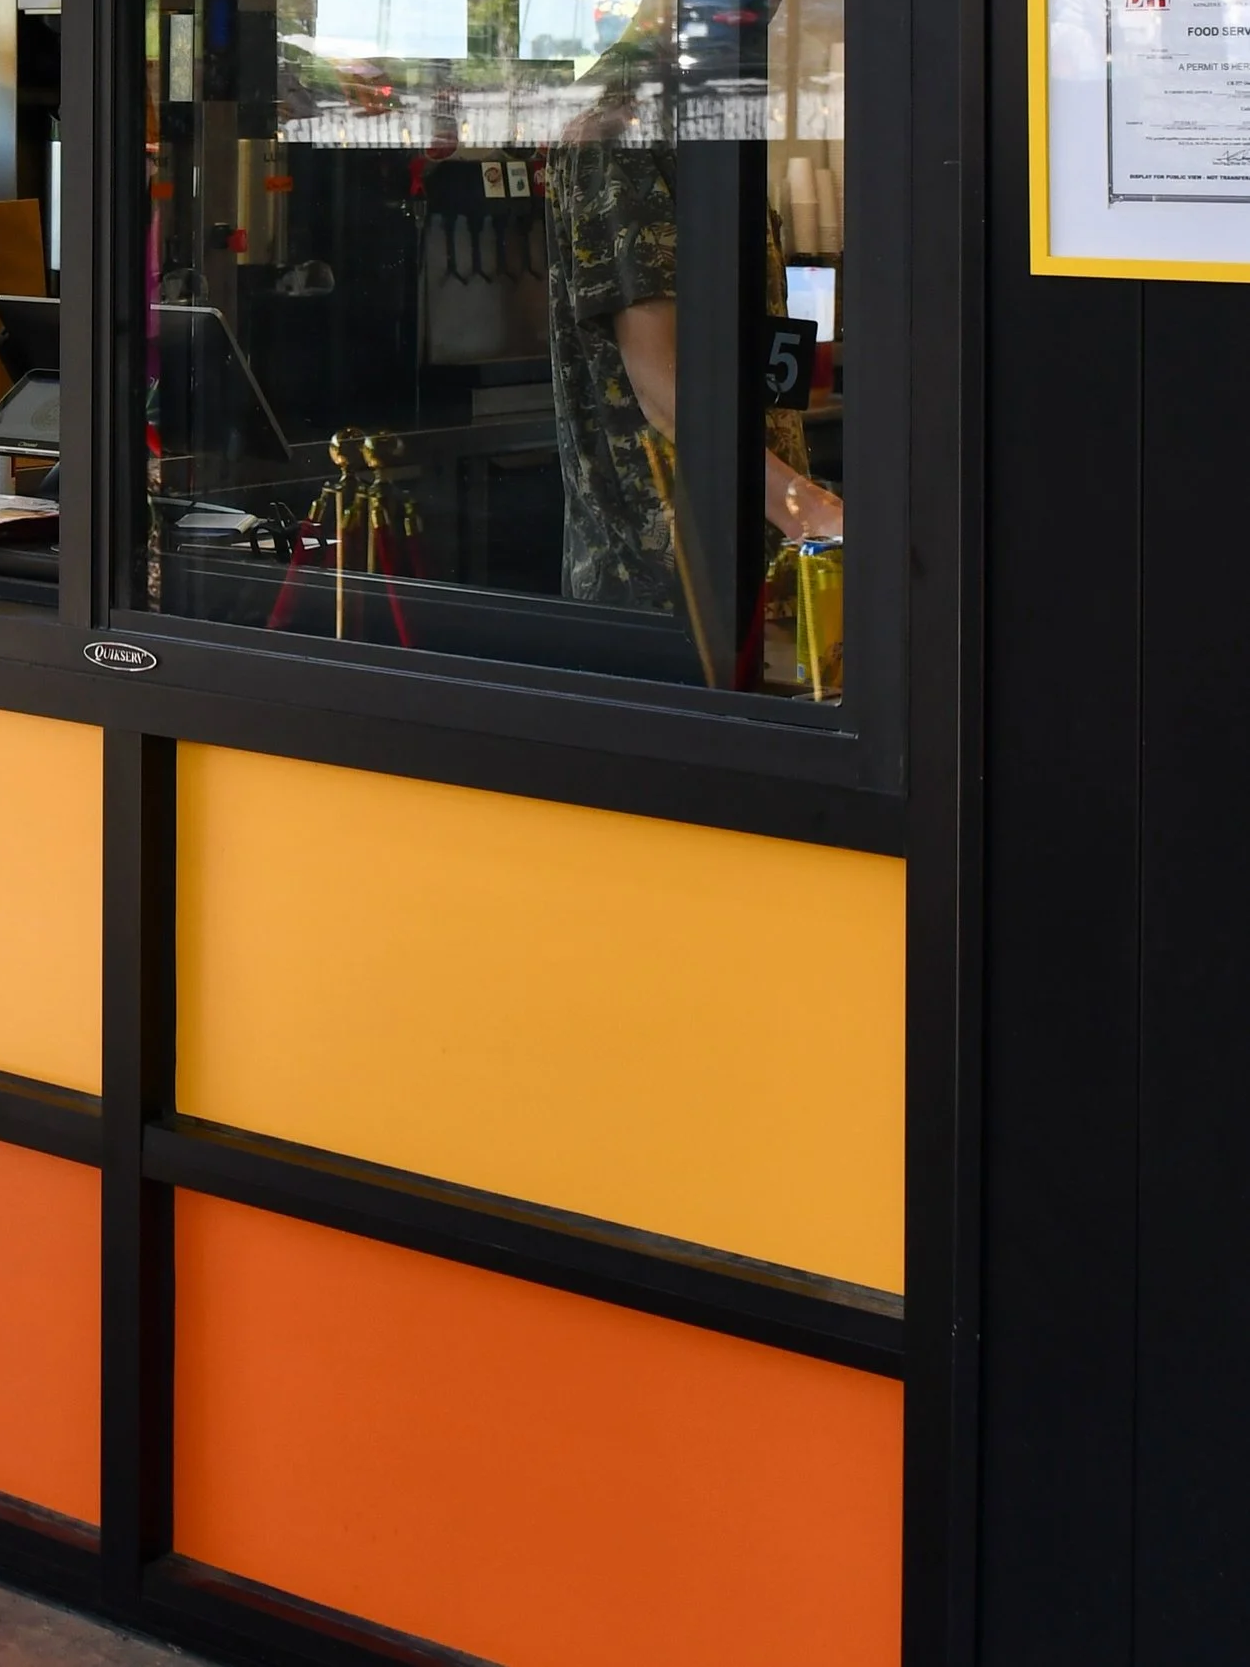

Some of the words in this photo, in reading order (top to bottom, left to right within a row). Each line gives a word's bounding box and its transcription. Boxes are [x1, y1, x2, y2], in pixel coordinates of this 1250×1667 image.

[1187, 26, 1219, 37] FOOD
[1178, 62, 1185, 70] A
[1186, 62, 1218, 71] PERMIT
[1221, 62, 1229, 71] IS
